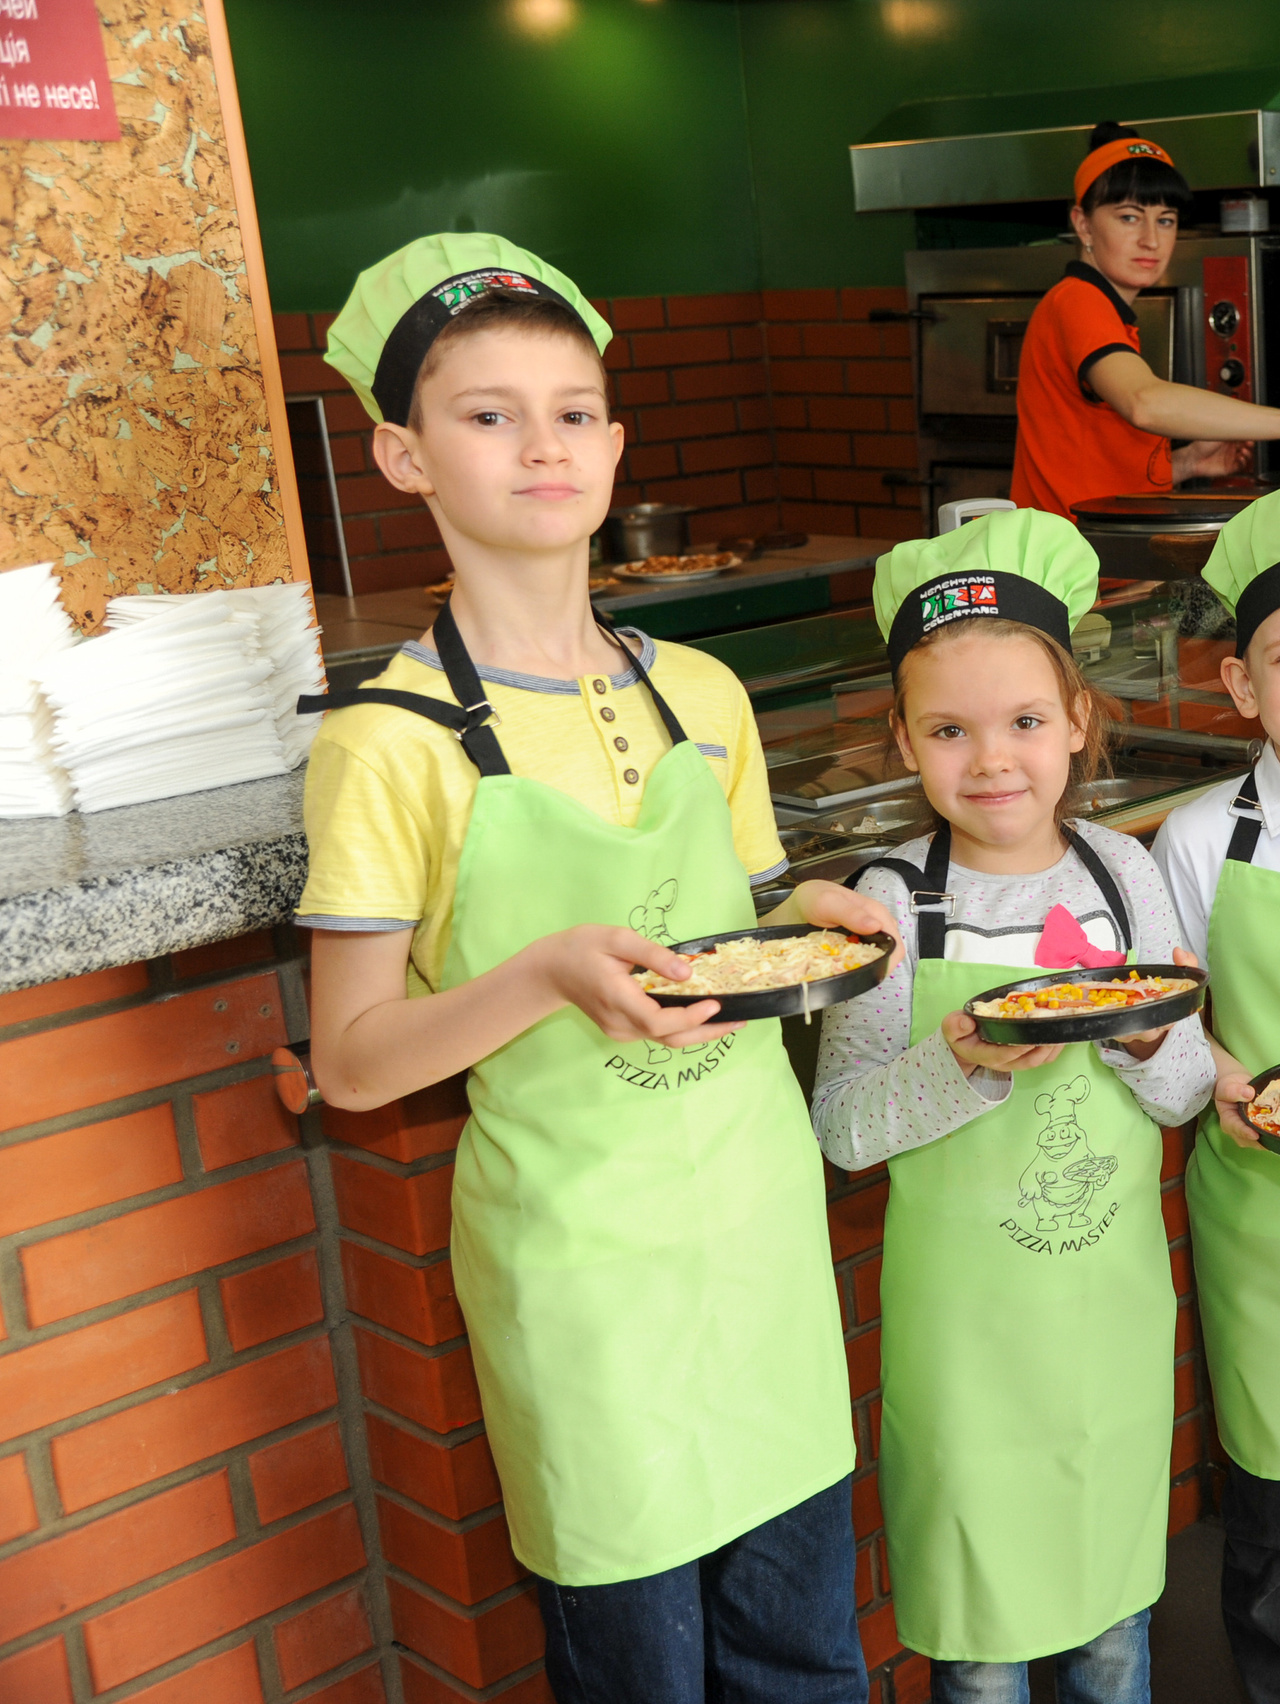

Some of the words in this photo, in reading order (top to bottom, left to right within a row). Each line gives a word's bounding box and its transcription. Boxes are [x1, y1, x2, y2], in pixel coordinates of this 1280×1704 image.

[14, 82, 41, 108] не
[44, 78, 100, 109] несе!
[604, 1054, 670, 1091] PIZZA
[677, 1031, 736, 1088] MASTE
[999, 1218, 1053, 1255] PIZZA
[1059, 1202, 1121, 1255] MASTER
